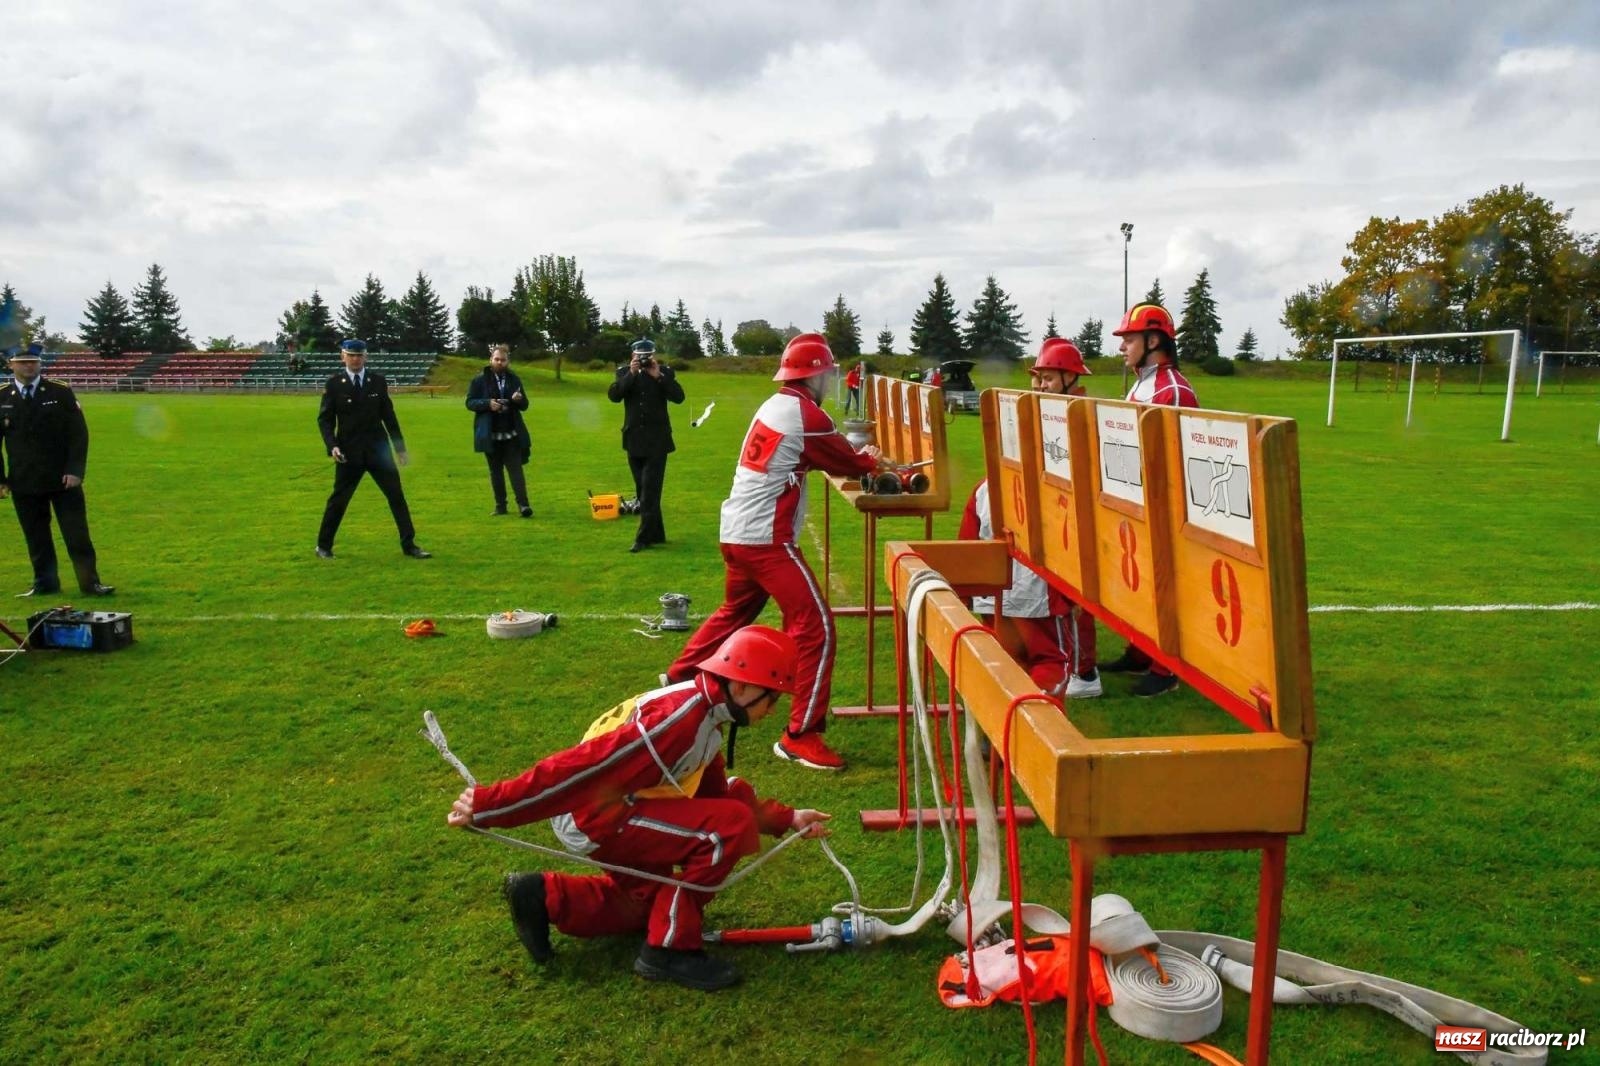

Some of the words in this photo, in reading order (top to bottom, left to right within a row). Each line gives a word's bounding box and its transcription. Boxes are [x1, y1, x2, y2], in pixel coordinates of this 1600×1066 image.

[747, 433, 767, 462] 5
[1207, 435, 1238, 449] MASZTOWY
[1013, 475, 1025, 525] 6
[1058, 494, 1069, 551] 7
[1119, 520, 1140, 592] 8
[1211, 559, 1242, 647] 9
